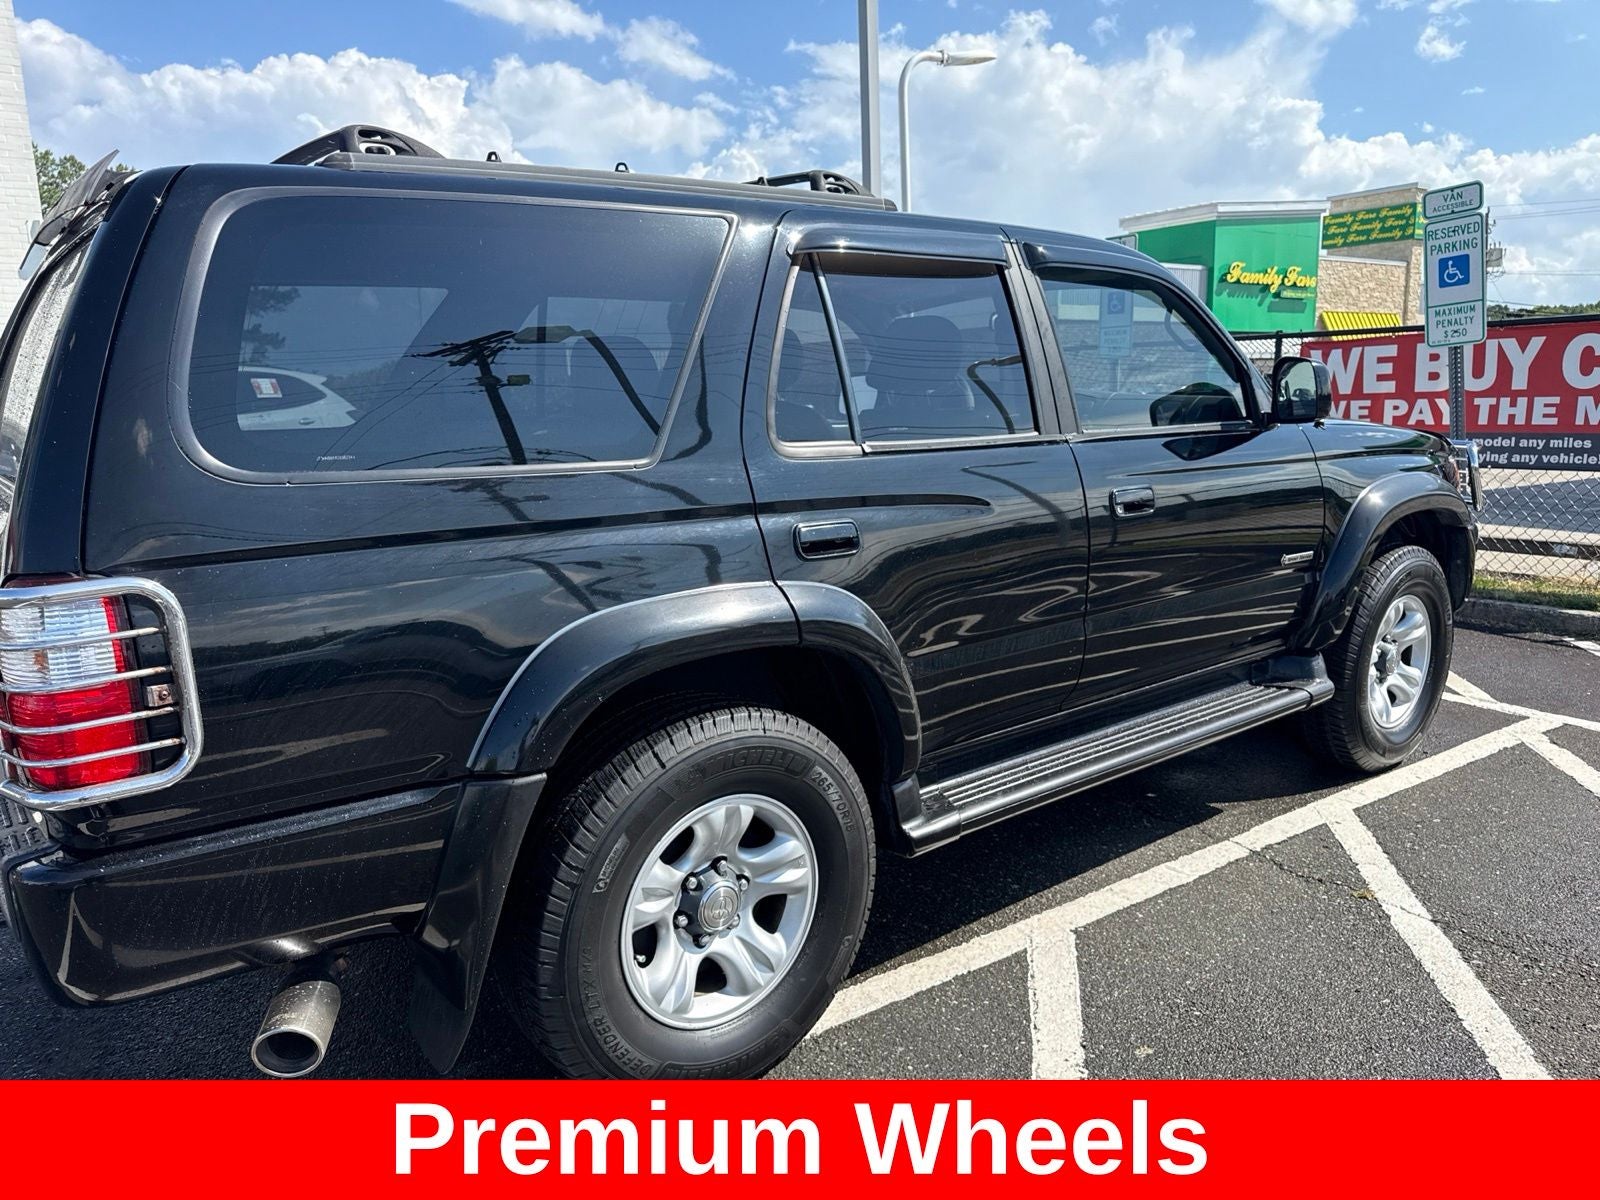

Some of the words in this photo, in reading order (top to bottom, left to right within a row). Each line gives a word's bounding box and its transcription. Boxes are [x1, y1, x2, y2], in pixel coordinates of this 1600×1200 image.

[1443, 191, 1464, 202] VAN
[1432, 199, 1474, 214] ACCESSIBLE
[1427, 221, 1481, 242] RESERVED
[1430, 237, 1479, 256] PARKING
[1226, 261, 1283, 294] Family
[1434, 304, 1476, 318] MAXIMUM
[1435, 316, 1475, 328] PENALTY
[1443, 328, 1468, 339] $250
[1310, 344, 1398, 395] WE
[1414, 336, 1547, 392] BUY
[1383, 398, 1450, 425] PAY
[1473, 396, 1560, 425] THE
[1519, 439, 1547, 450] any
[1549, 437, 1592, 449] miles
[1511, 453, 1538, 465] any
[1542, 452, 1600, 465] vehicle
[583, 979, 600, 1010] LTX
[593, 1015, 650, 1076] DEFENDER
